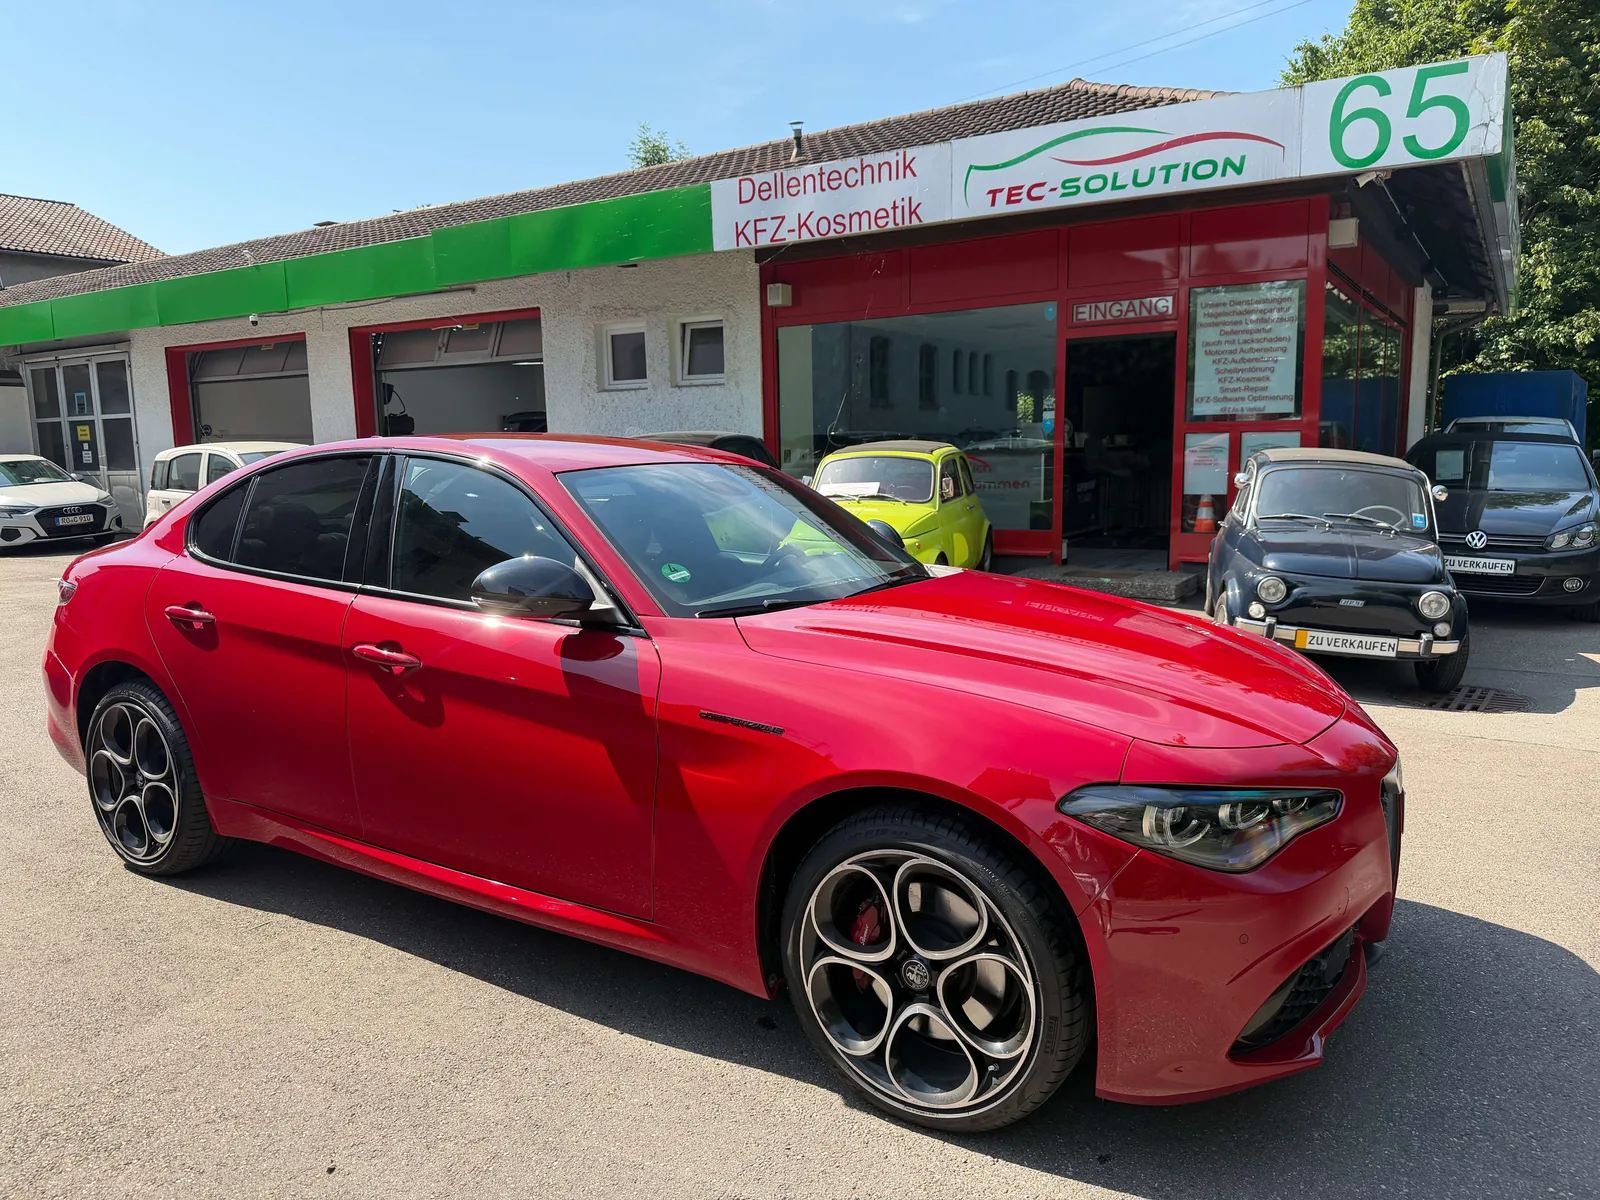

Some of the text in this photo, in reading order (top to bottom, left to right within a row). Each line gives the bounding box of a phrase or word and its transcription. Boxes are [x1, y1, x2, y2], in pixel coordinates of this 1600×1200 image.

[1329, 61, 1470, 169] 65
[738, 150, 917, 205] Dellentechnik
[985, 154, 1247, 208] TEC-SOLUTION
[735, 196, 924, 247] KFZ-Kosmetik
[1075, 297, 1170, 321] EINGANG
[1201, 301, 1228, 309] Unsere
[1203, 306, 1292, 319] Hagelschadenreparatur
[1196, 319, 1243, 330] (kostenloses
[1201, 335, 1291, 349] (auch mit Lackschaden)
[1204, 345, 1288, 357] Motorrad Aufbereitung
[1211, 356, 1279, 366] KFZ-Aufbereitung
[1214, 365, 1275, 375] Scheibentönung
[1217, 374, 1272, 384] KFZ-Kosmetik
[1219, 384, 1269, 394] Smart-Repair
[1194, 393, 1294, 404] KFZ-Software Optimierung
[974, 480, 1031, 490] ommen
[1457, 560, 1514, 572] VERKAUFEN
[1308, 635, 1396, 652] ZU VERKAUFEN
